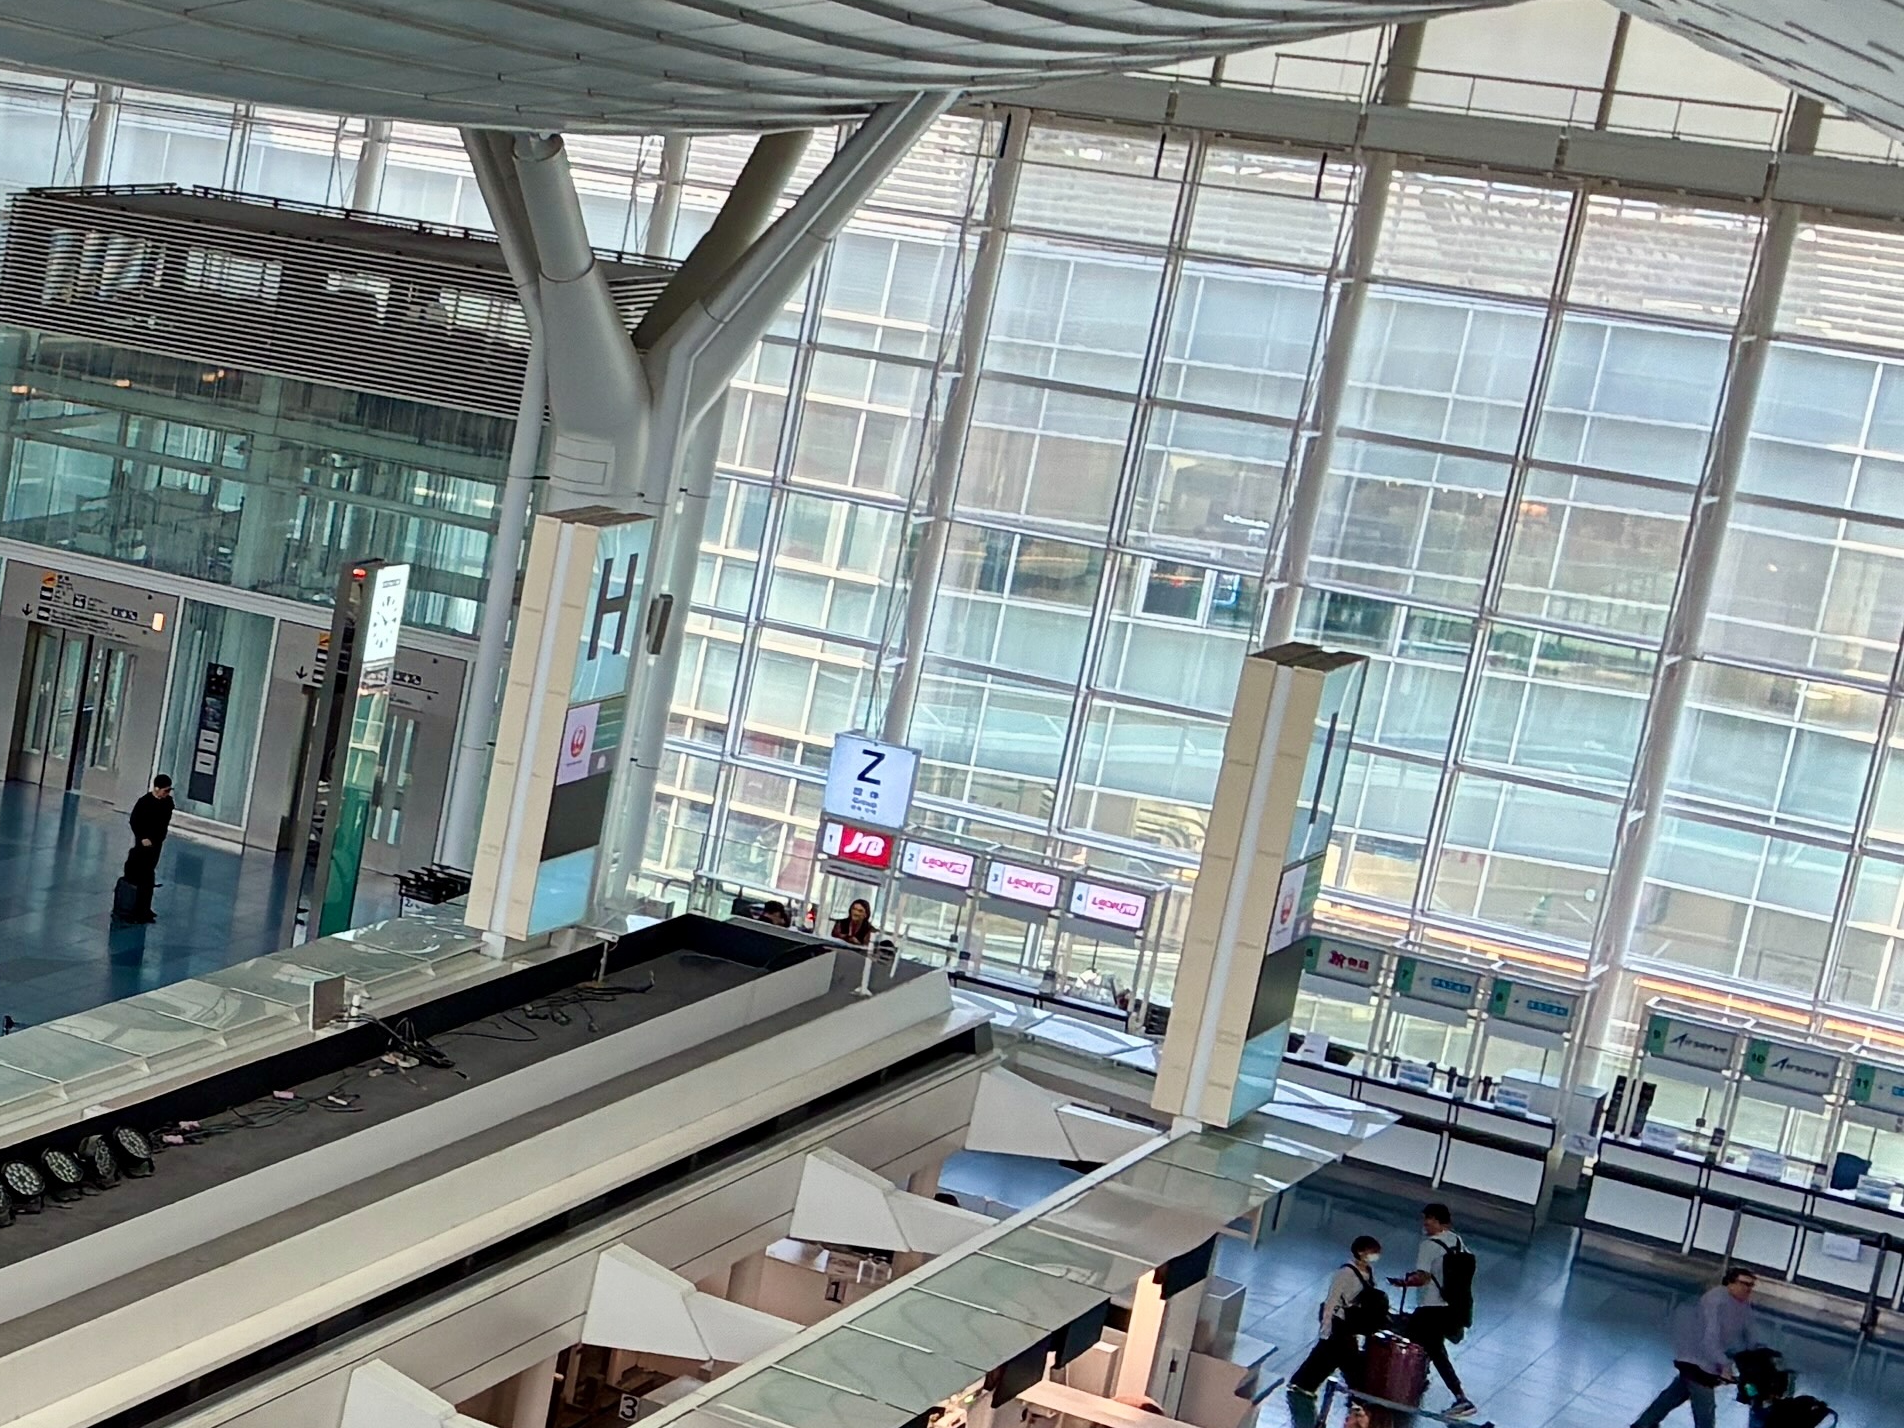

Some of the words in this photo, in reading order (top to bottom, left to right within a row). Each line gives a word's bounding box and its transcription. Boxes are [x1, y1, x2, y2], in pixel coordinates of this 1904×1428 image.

[588, 553, 638, 661] H
[857, 749, 885, 785] Z
[843, 833, 885, 857] JTB
[1751, 1052, 1766, 1065] 10
[832, 1281, 842, 1304] 1
[621, 1396, 638, 1419] 3
